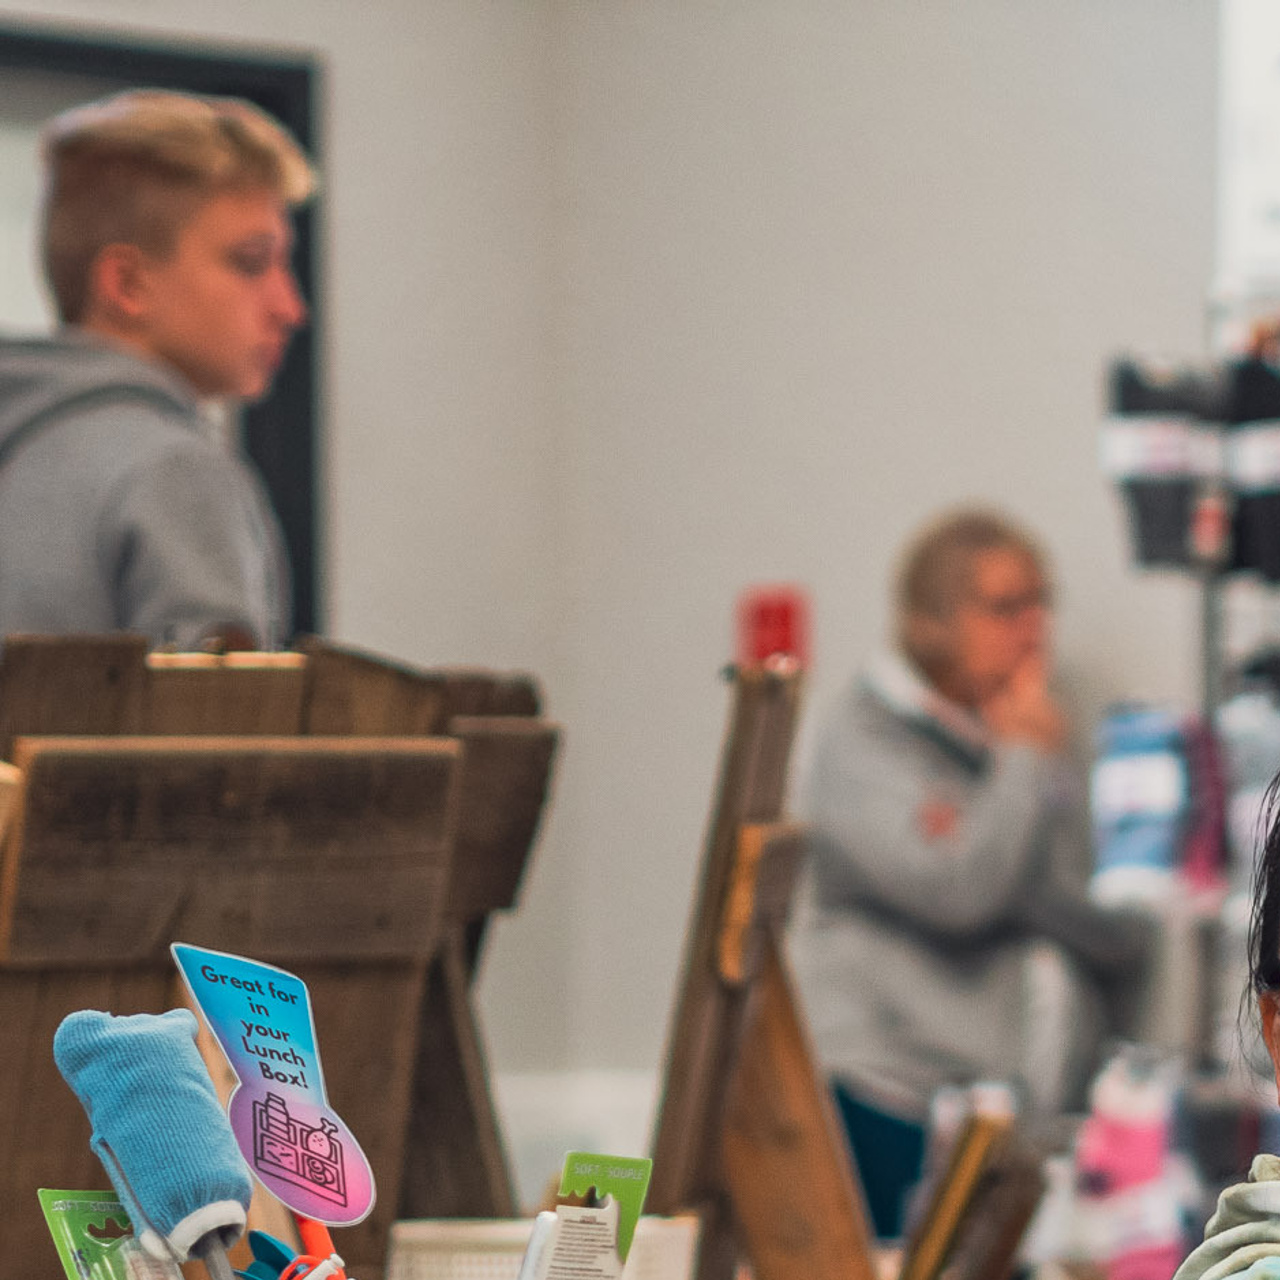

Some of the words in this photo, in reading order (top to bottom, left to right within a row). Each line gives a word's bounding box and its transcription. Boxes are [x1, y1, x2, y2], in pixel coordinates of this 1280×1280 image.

[201, 965, 266, 997] Great
[268, 982, 299, 1005] for
[249, 997, 270, 1017] in
[241, 1019, 291, 1043] your
[241, 1035, 307, 1068] Lunch
[258, 1061, 309, 1089] Box!
[573, 1163, 601, 1175] SOFT
